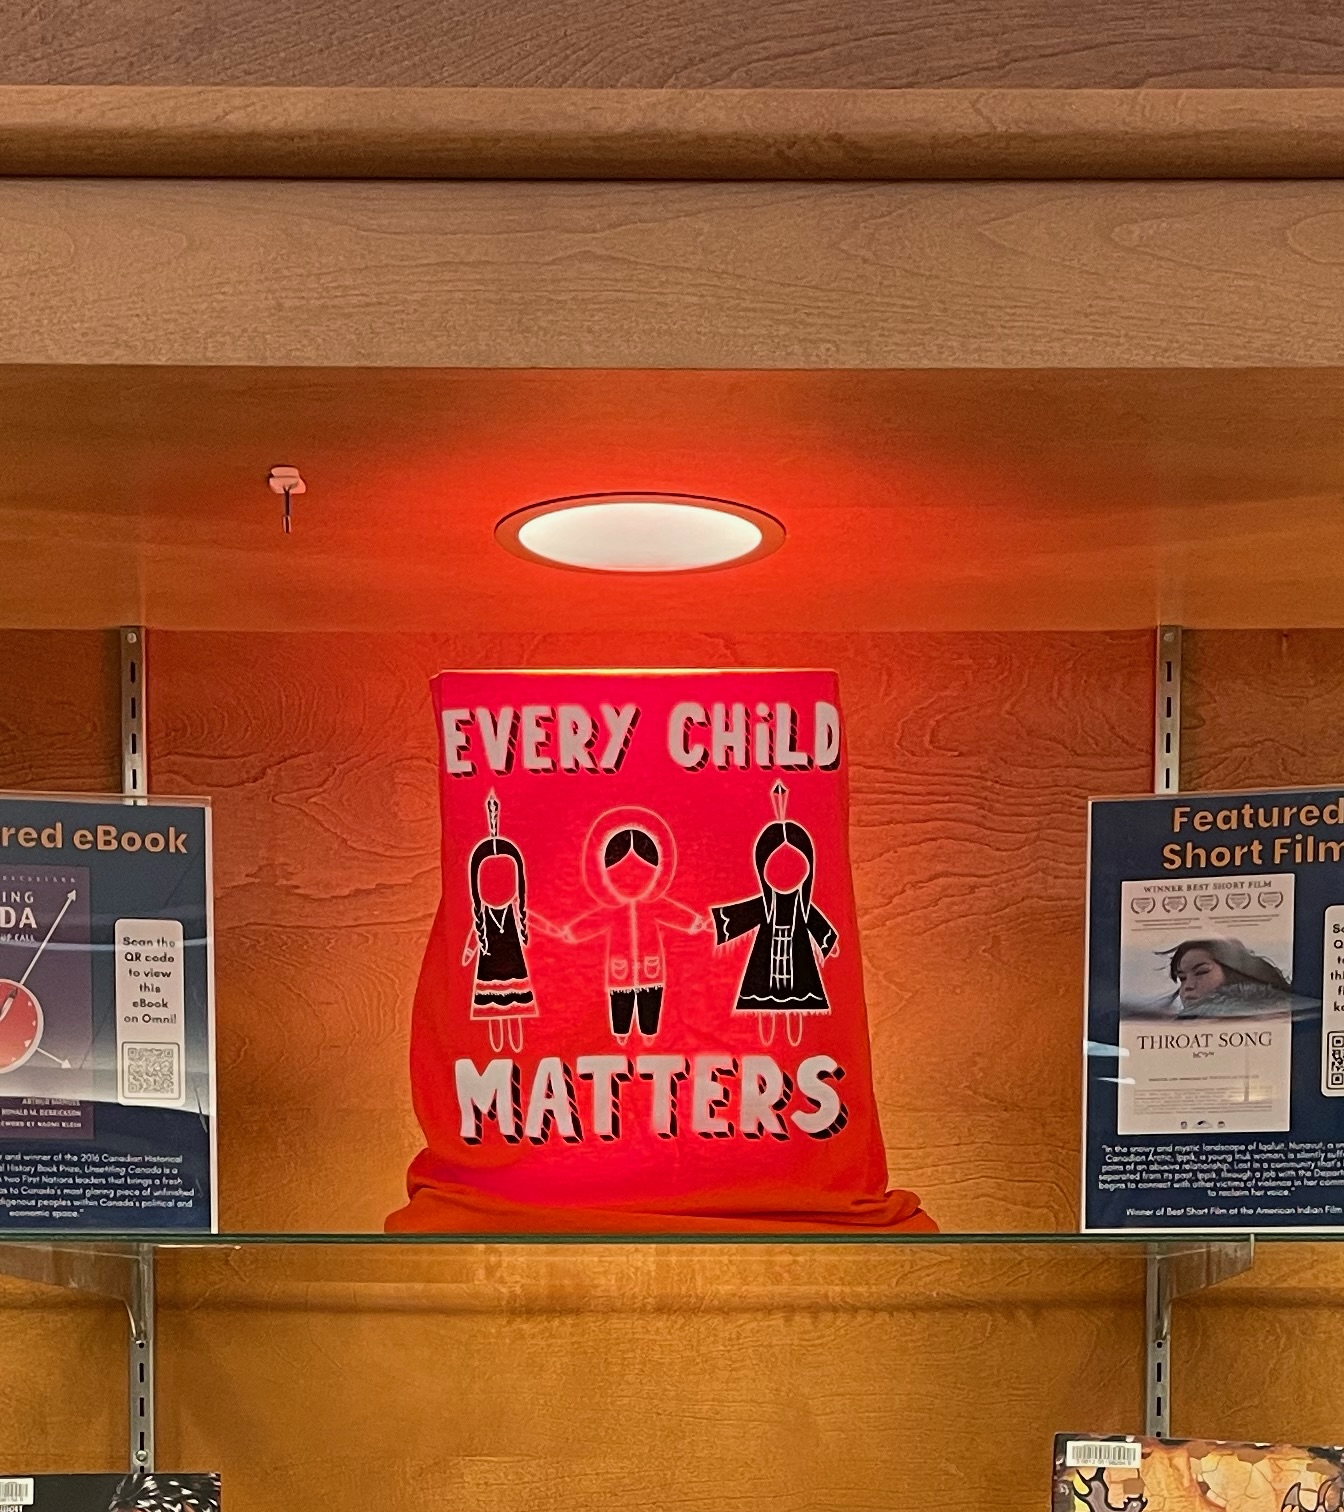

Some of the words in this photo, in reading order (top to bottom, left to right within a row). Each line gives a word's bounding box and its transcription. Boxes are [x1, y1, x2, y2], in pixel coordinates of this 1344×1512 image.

[441, 704, 643, 778] EVERY
[72, 822, 189, 855] eBook
[1162, 840, 1263, 871] Short
[1144, 885, 1183, 893] WINNER
[1213, 882, 1245, 890] SHORT
[1136, 1033, 1213, 1051] THROAT
[1218, 1031, 1273, 1049] SONG
[453, 1054, 850, 1145] MATTERS
